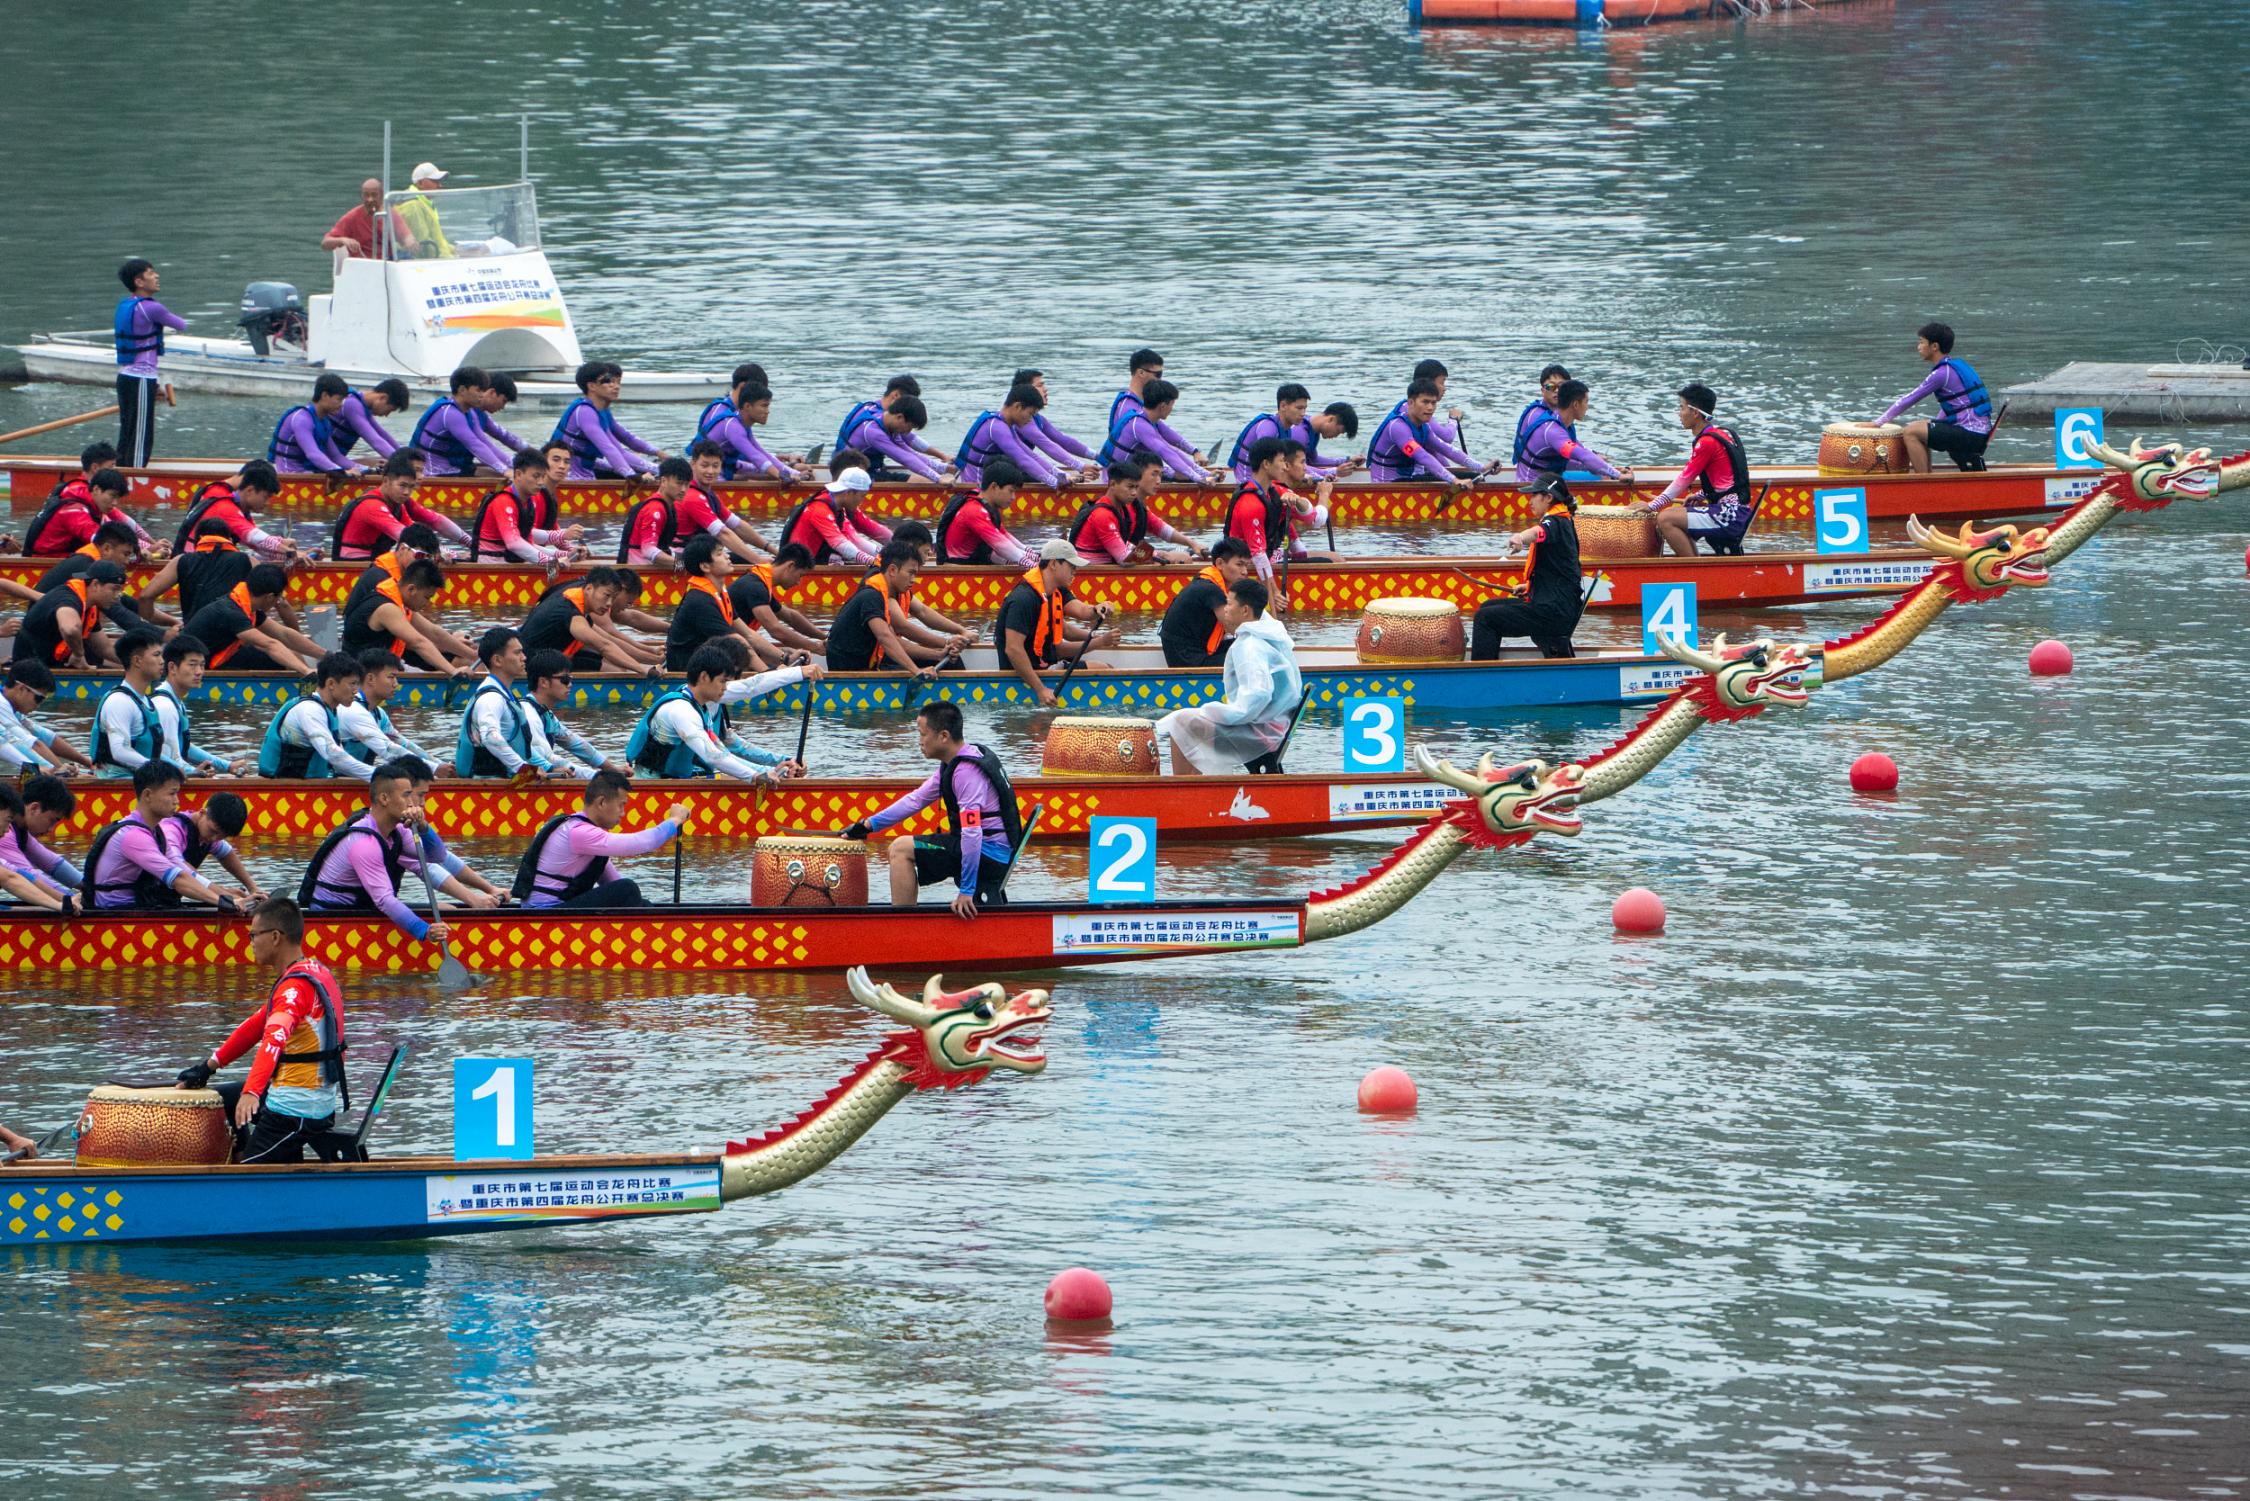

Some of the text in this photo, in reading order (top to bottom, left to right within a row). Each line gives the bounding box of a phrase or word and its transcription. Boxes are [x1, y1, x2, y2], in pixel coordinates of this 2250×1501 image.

[2061, 412, 2096, 462] 6
[1822, 494, 1860, 546] 5
[1647, 588, 1691, 645] 4
[1350, 702, 1396, 765] 3
[966, 812, 976, 825] C
[1096, 823, 1147, 892] 2
[1080, 932, 1270, 944] 暨重庆市第四届龙舟公开赛总决赛
[1091, 920, 1259, 931] 重庆市第七届运动会龙舟比赛
[472, 1067, 515, 1146] 1
[459, 1191, 685, 1210] 暨重庆市第四届龙舟公开赛总决赛
[471, 1177, 672, 1195] 重庆市第七届运动会龙舟比赛
